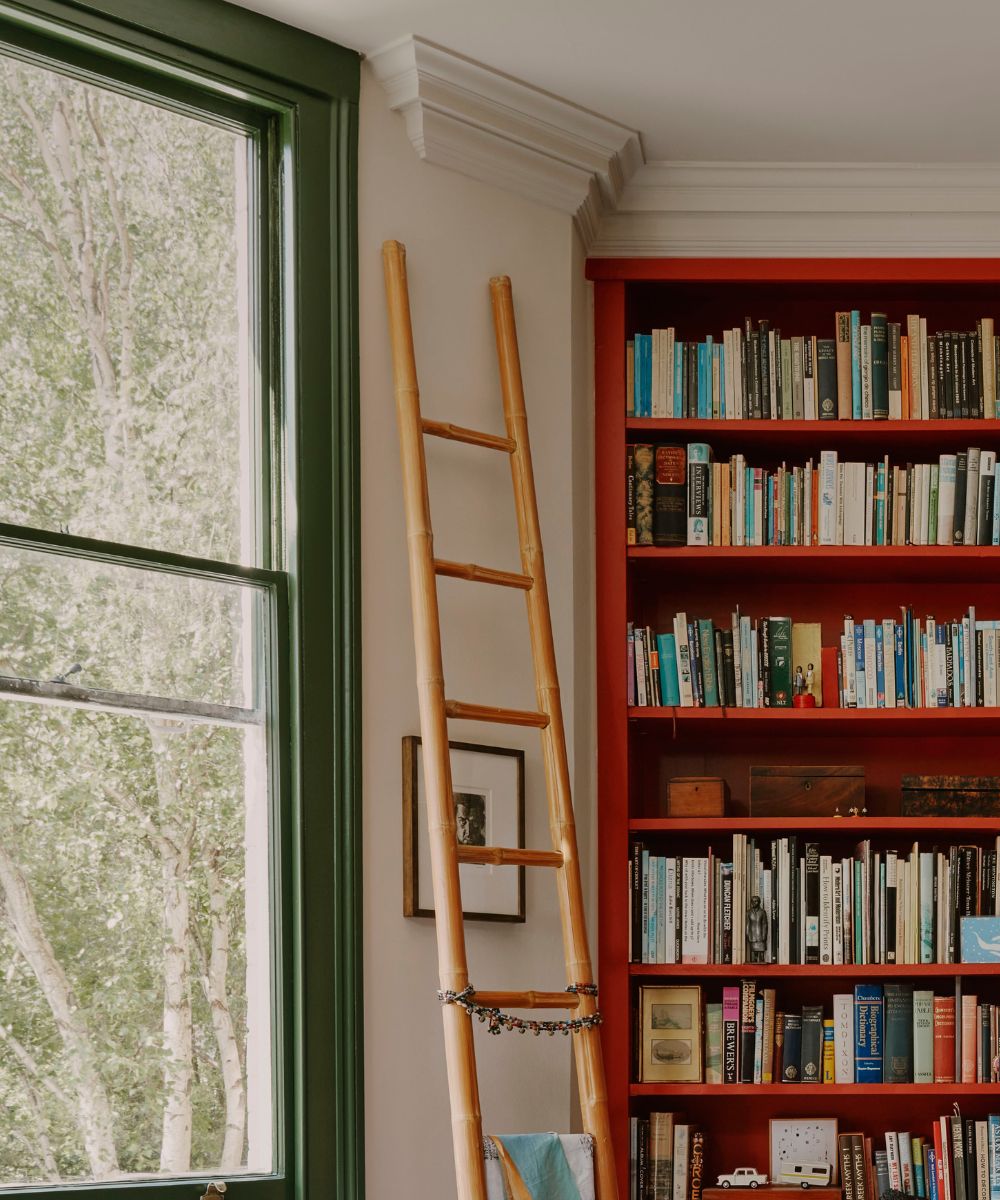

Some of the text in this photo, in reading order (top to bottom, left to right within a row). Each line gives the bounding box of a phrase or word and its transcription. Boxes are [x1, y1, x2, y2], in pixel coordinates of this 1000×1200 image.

[726, 1022, 734, 1071] BREWER'S
[857, 1005, 869, 1047] Dictionary
[868, 1005, 880, 1055] Biographical
[855, 1154, 863, 1180] MYTHS
[954, 1141, 963, 1158] MOORE
